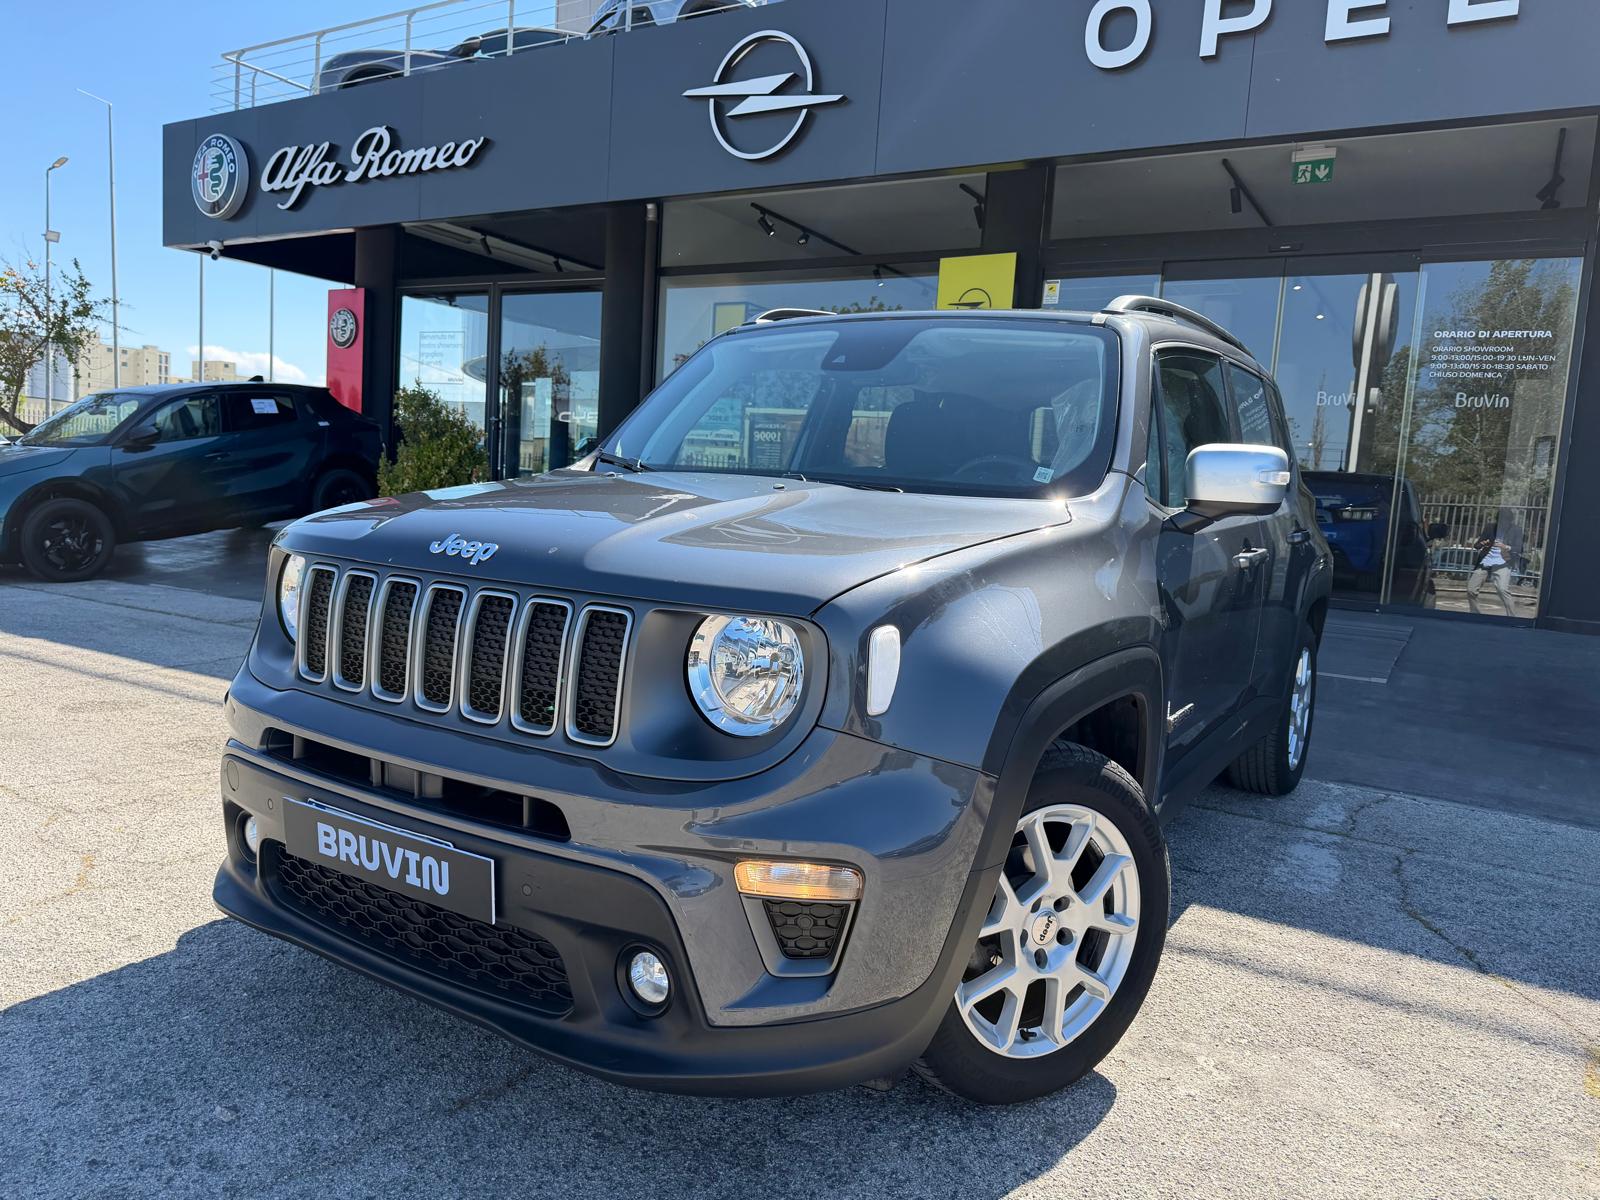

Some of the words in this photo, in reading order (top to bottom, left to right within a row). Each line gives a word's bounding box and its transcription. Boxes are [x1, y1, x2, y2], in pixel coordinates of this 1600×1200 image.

[210, 138, 236, 173] ROMEO
[260, 141, 342, 210] Alfa
[345, 125, 484, 182] Romeo
[1434, 330, 1476, 338] ORARIO
[1478, 330, 1490, 338] DI
[1492, 330, 1552, 338] APERTURA
[1316, 391, 1358, 406] BruVi
[1455, 392, 1510, 408] BruVin
[429, 533, 499, 565] Jeep
[316, 822, 450, 896] BRUVIN
[1039, 915, 1053, 942] Jeep
